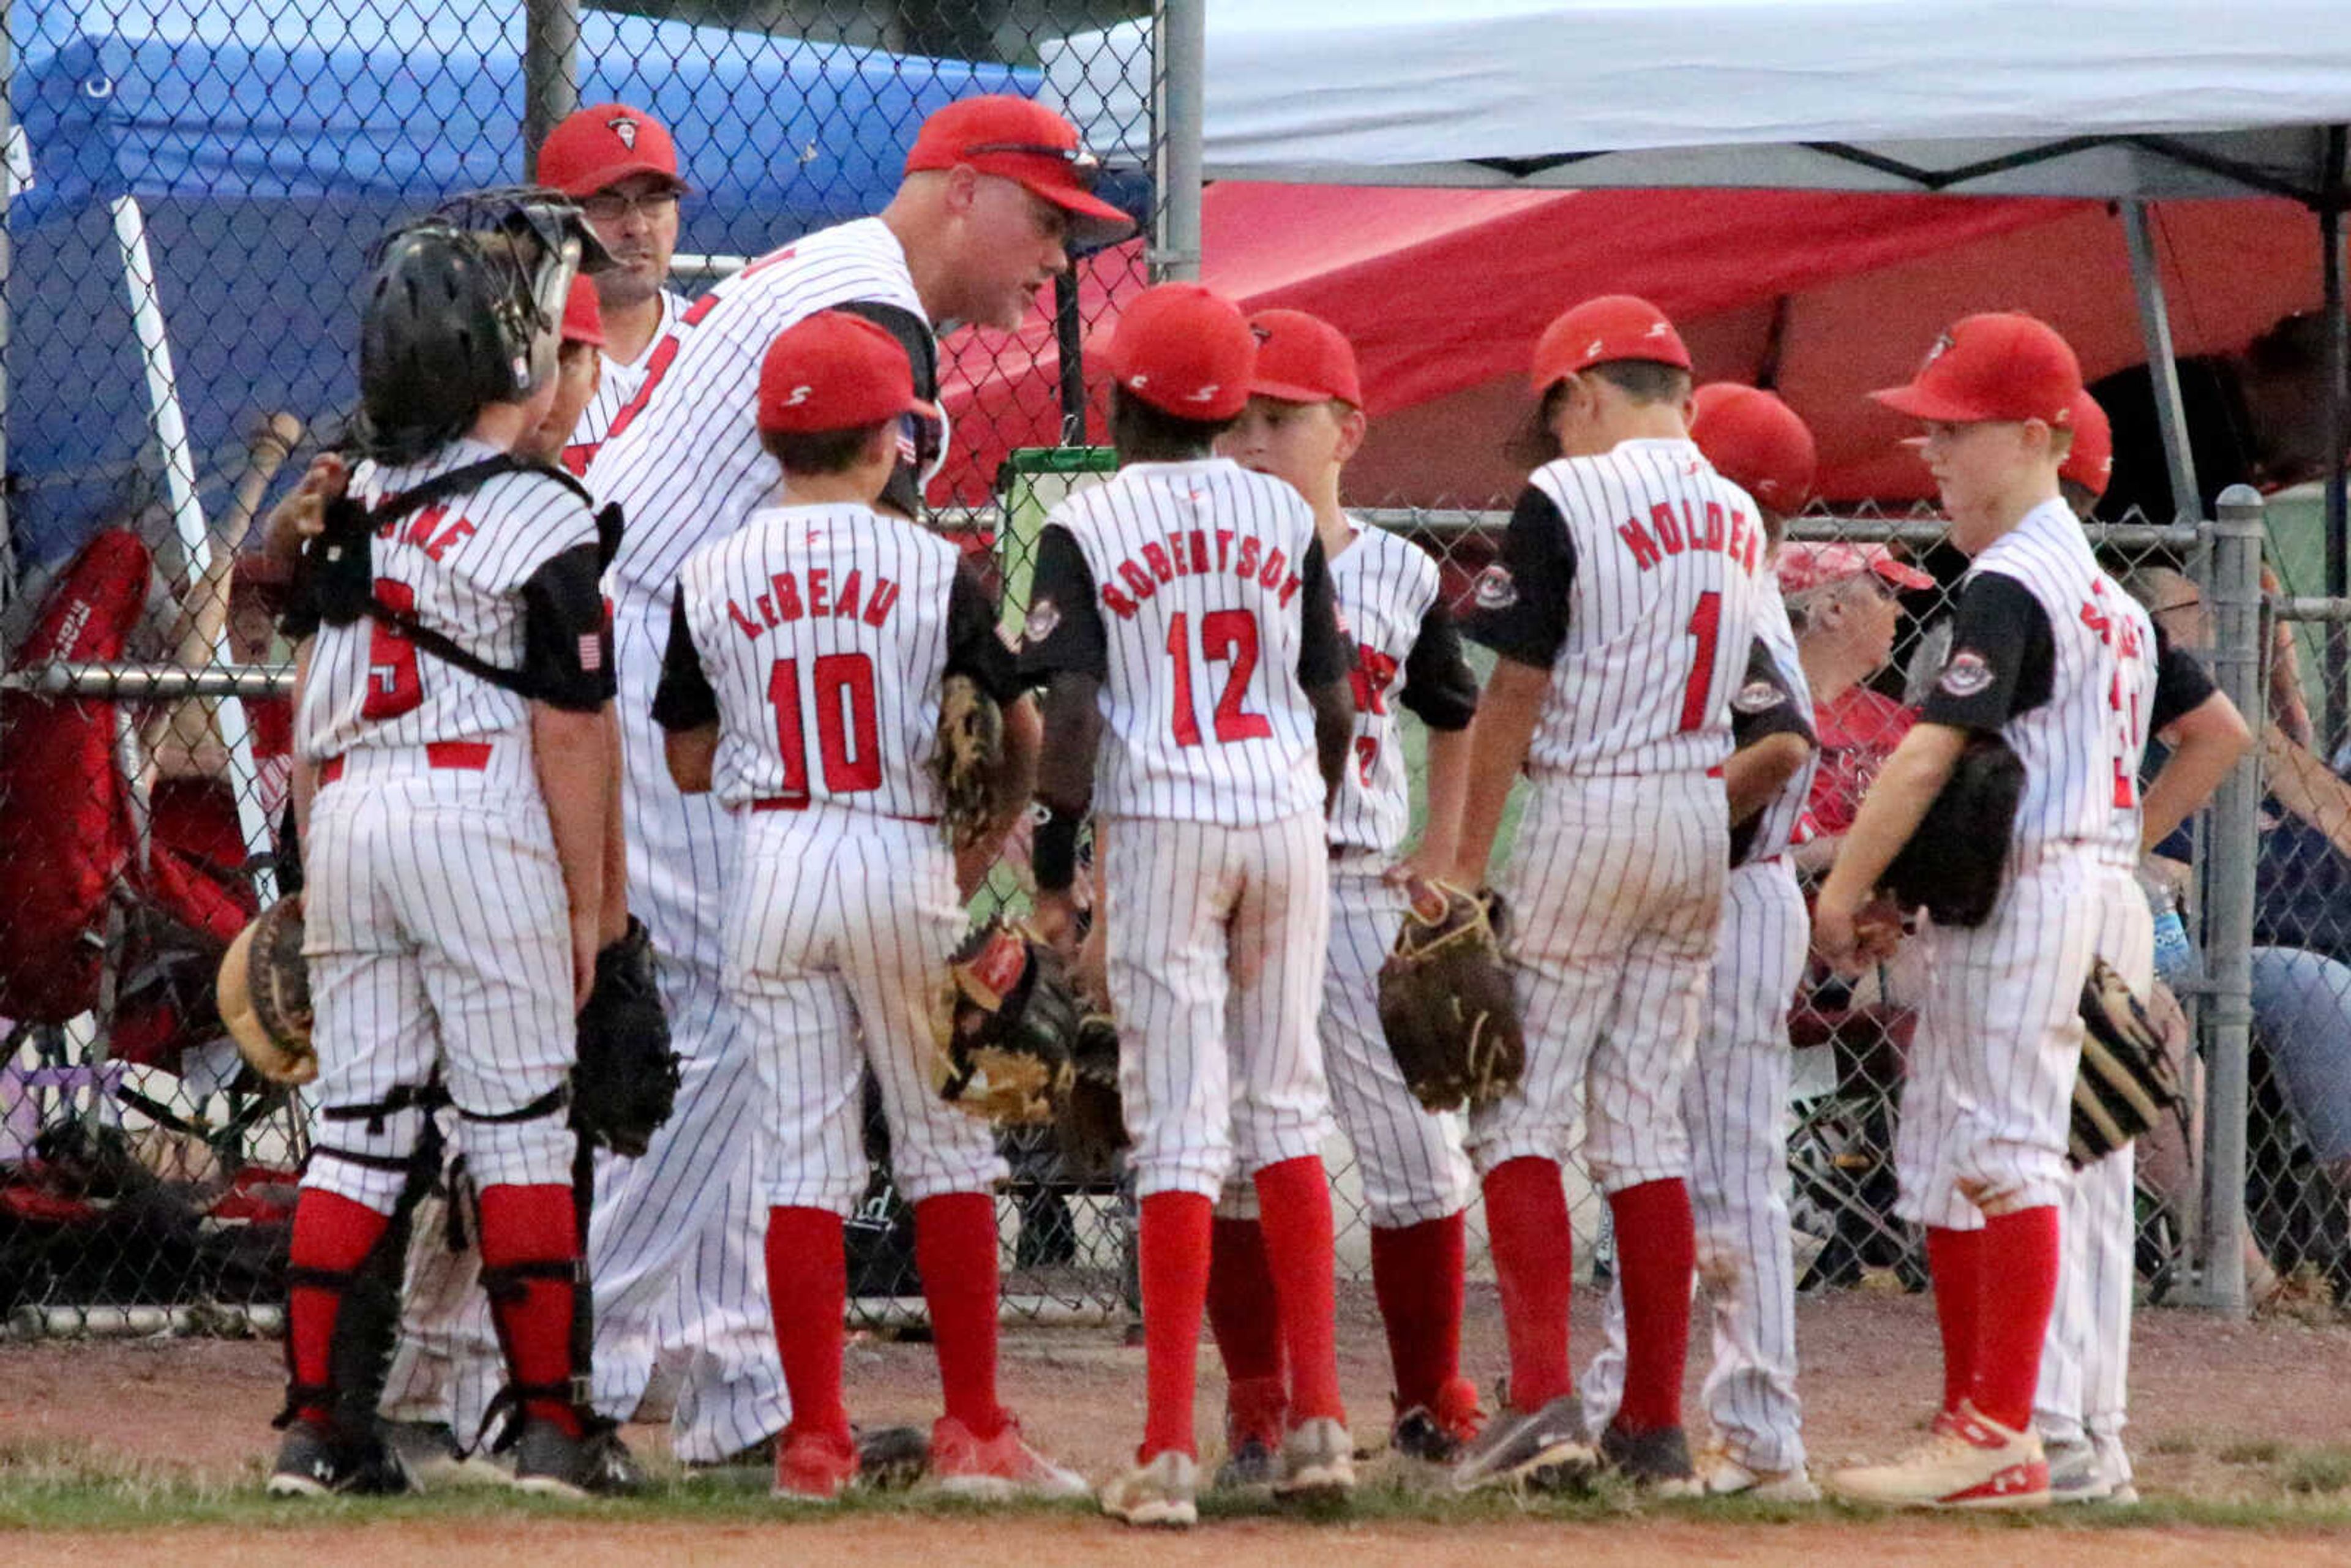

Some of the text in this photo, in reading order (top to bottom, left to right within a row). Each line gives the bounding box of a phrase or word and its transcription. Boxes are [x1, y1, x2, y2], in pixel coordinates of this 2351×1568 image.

[767, 651, 882, 795] 10
[1166, 608, 1273, 748] 12
[1678, 591, 1722, 733] 1
